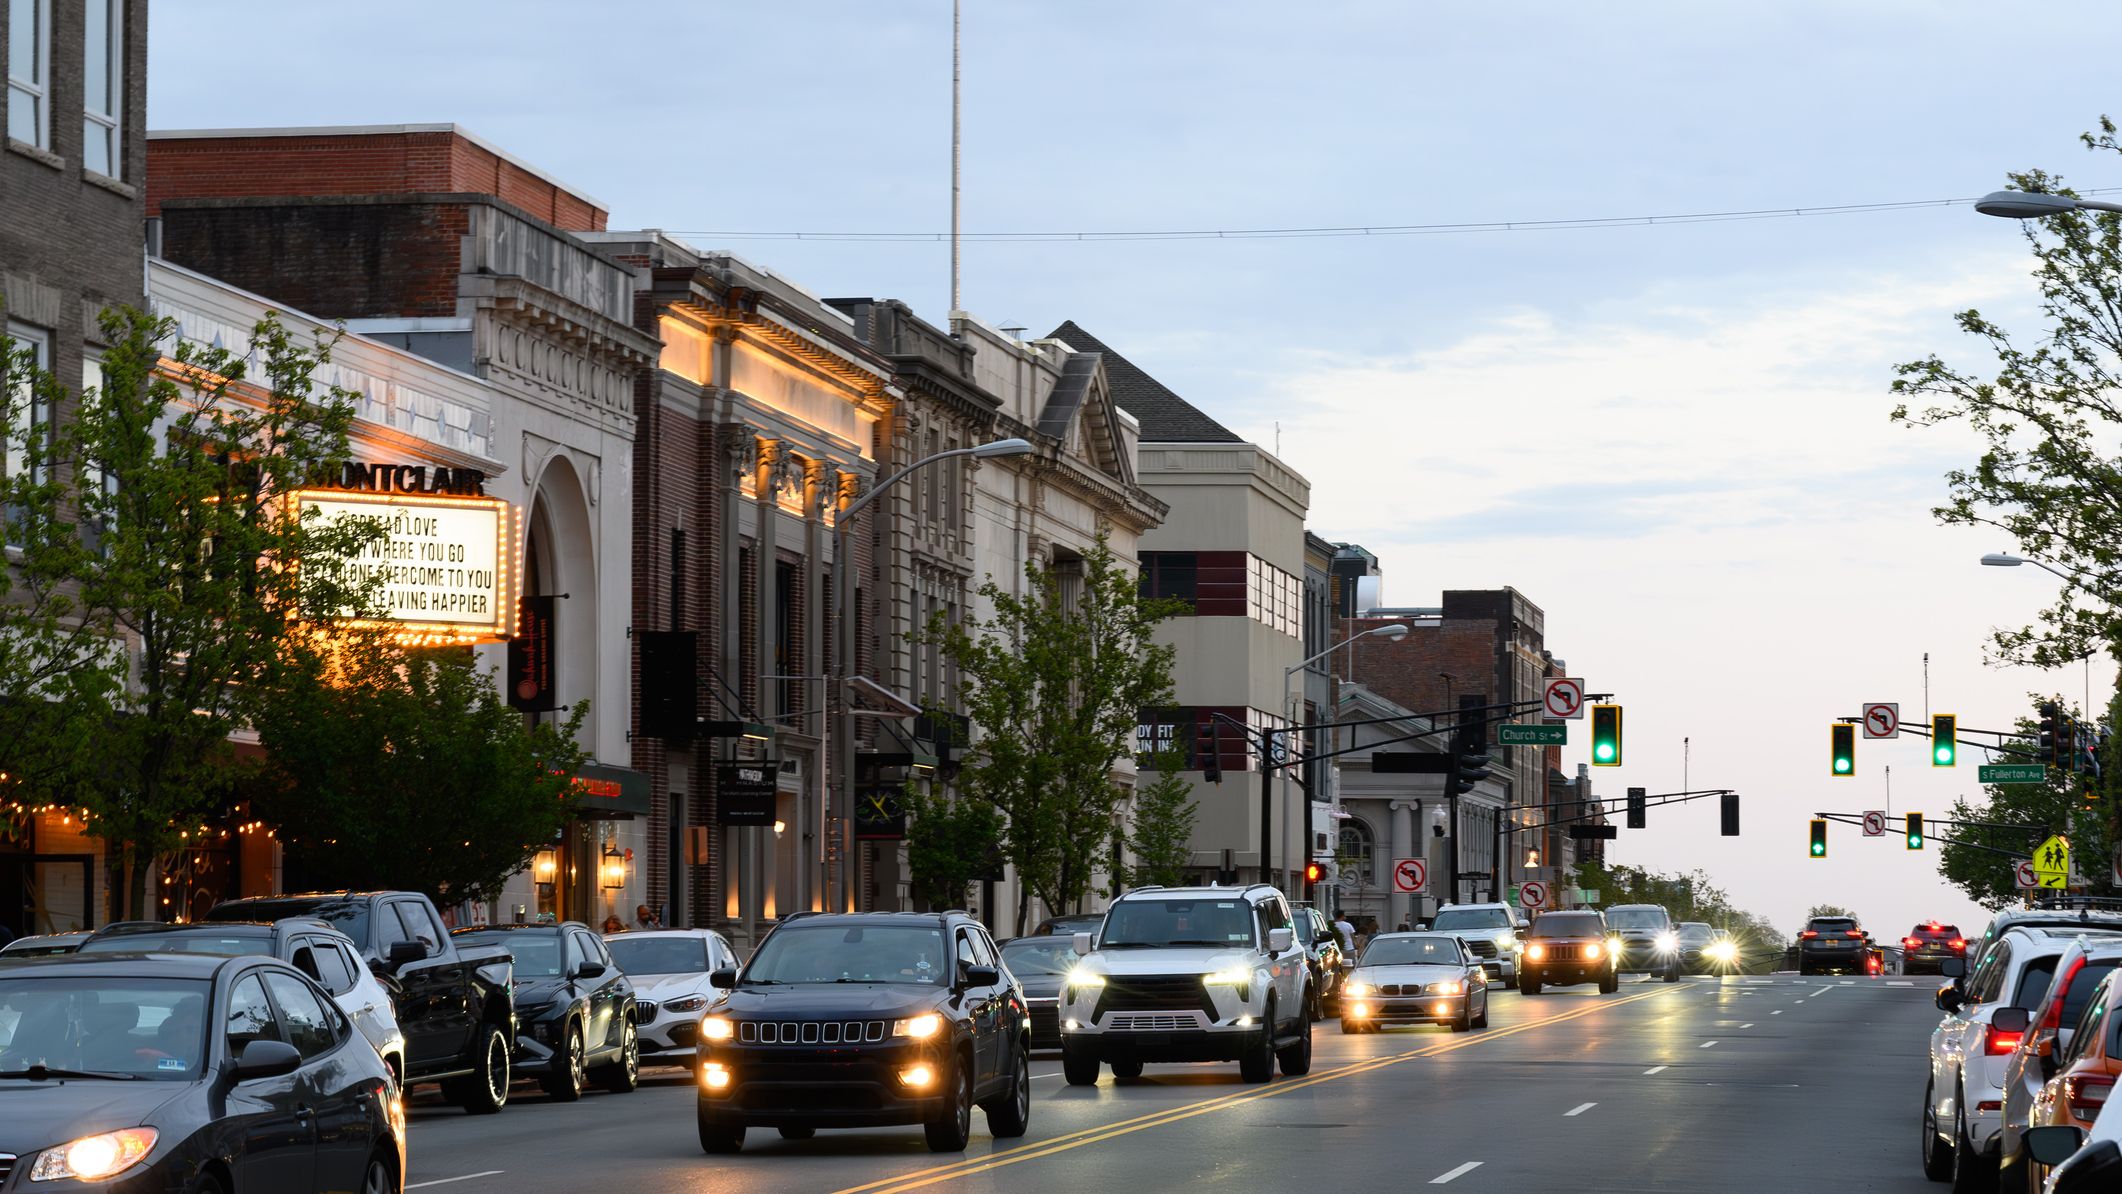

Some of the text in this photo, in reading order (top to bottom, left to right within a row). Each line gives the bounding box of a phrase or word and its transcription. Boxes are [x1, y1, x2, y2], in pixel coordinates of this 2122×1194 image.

[319, 461, 485, 495] ONTCLAIR
[406, 515, 437, 537] LOVE
[420, 542, 444, 562] YOU
[448, 543, 465, 563] GO
[447, 568, 464, 588] TO
[468, 569, 492, 590] YOU
[372, 589, 488, 614] LEAVING HAPPIER
[1137, 724, 1175, 738] DY FIT
[1502, 729, 1548, 740] Church St
[1989, 769, 2026, 779] Fullerton
[2028, 771, 2041, 779] Ave
